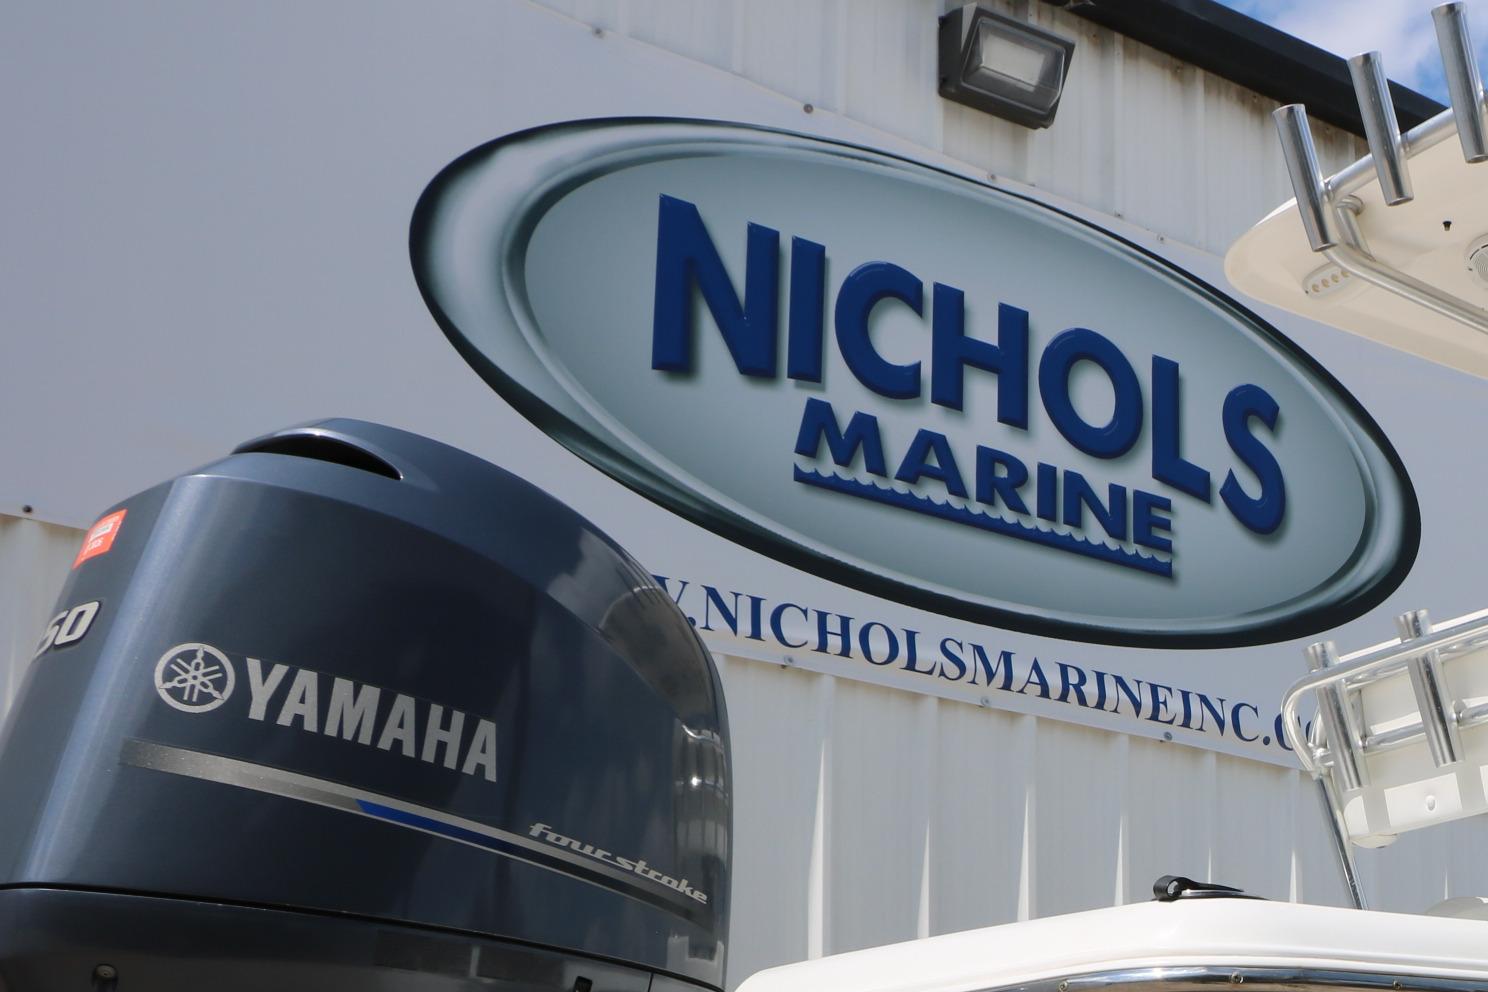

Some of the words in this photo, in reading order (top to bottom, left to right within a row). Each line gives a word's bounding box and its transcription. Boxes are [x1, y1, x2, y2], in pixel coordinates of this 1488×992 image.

[651, 193, 1287, 536] NICHOLS
[793, 397, 1172, 553] MARINE
[246, 657, 497, 782] YAMAHA
